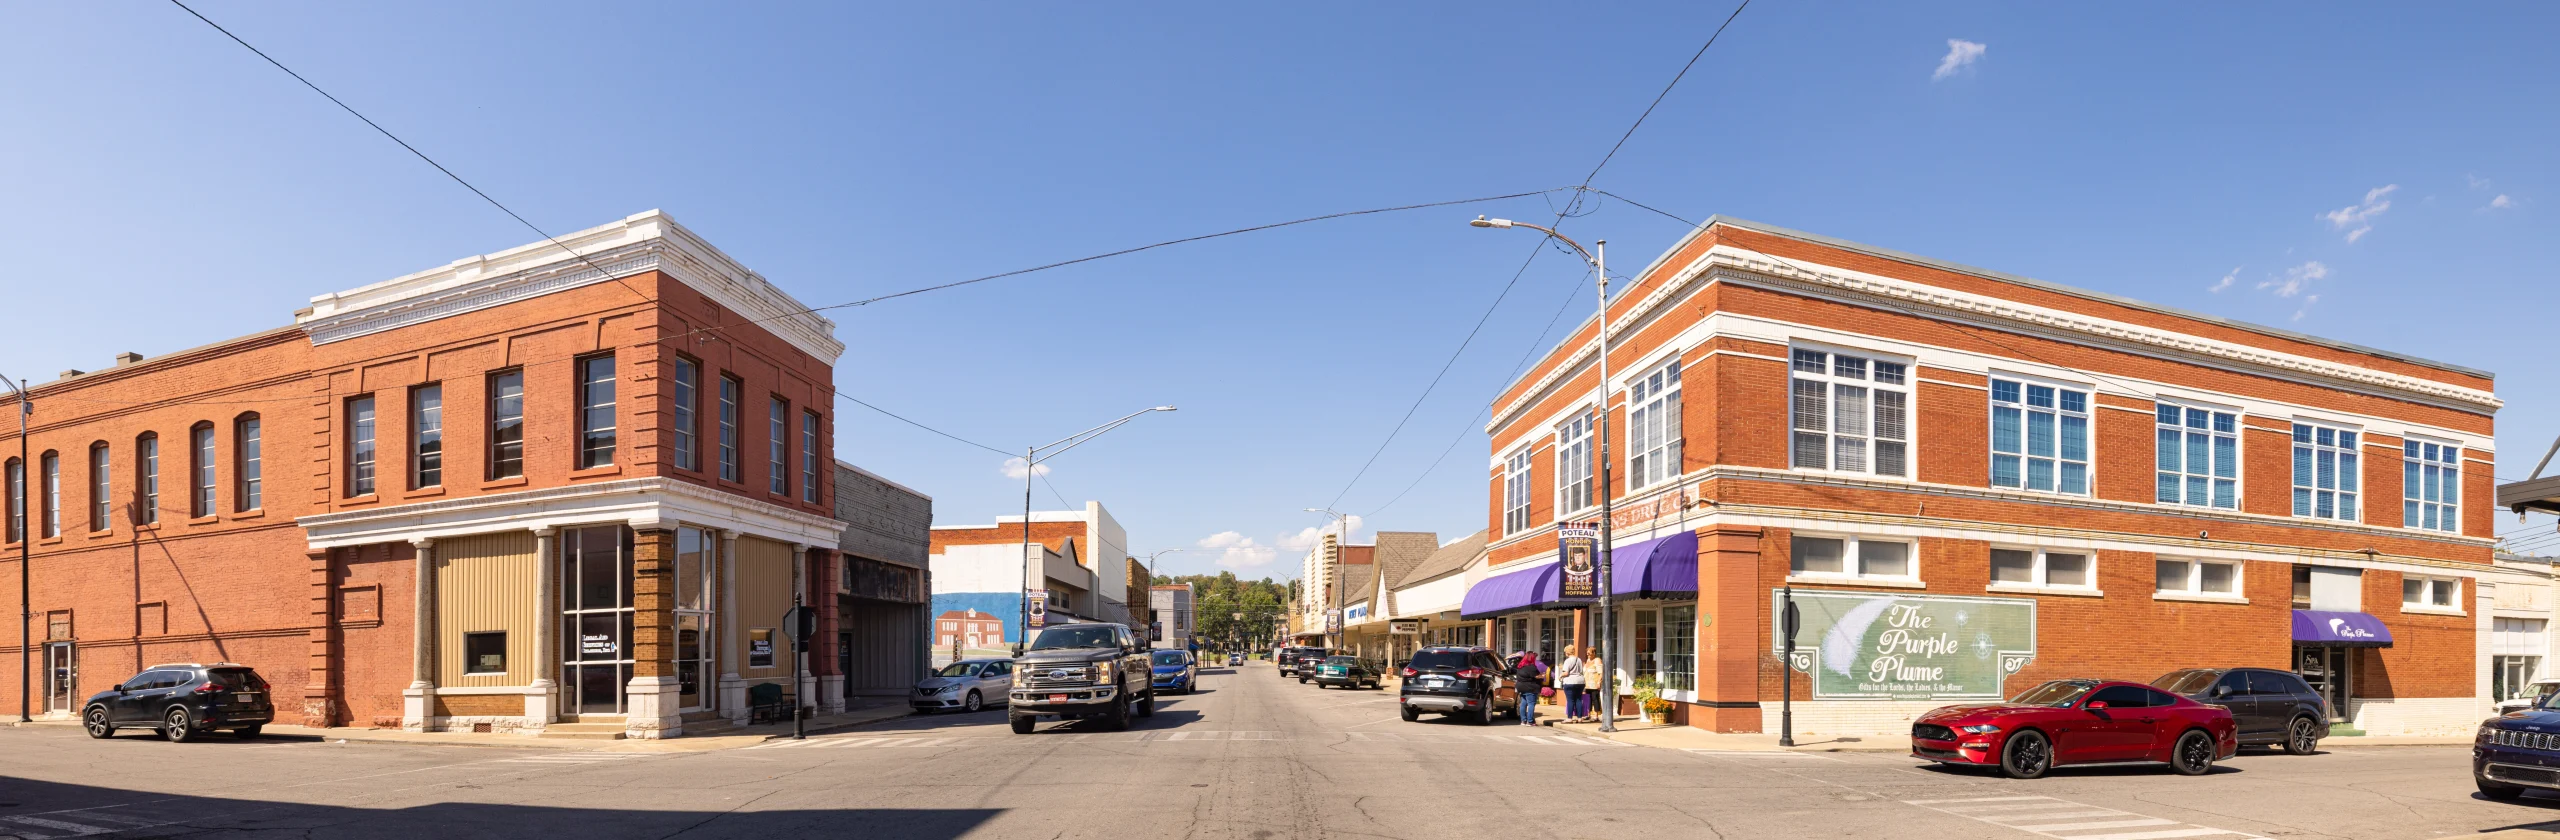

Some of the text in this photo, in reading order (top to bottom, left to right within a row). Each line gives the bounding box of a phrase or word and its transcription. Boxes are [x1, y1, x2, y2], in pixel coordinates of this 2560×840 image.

[1561, 529, 1595, 537] POTEAU
[1888, 603, 1932, 628] The
[1876, 628, 1958, 659] Purple
[1868, 653, 1944, 683] Plume
[1858, 683, 1872, 691] Gifts
[1880, 683, 1888, 692] the
[1906, 683, 1914, 692] the
[1933, 683, 1939, 691] &
